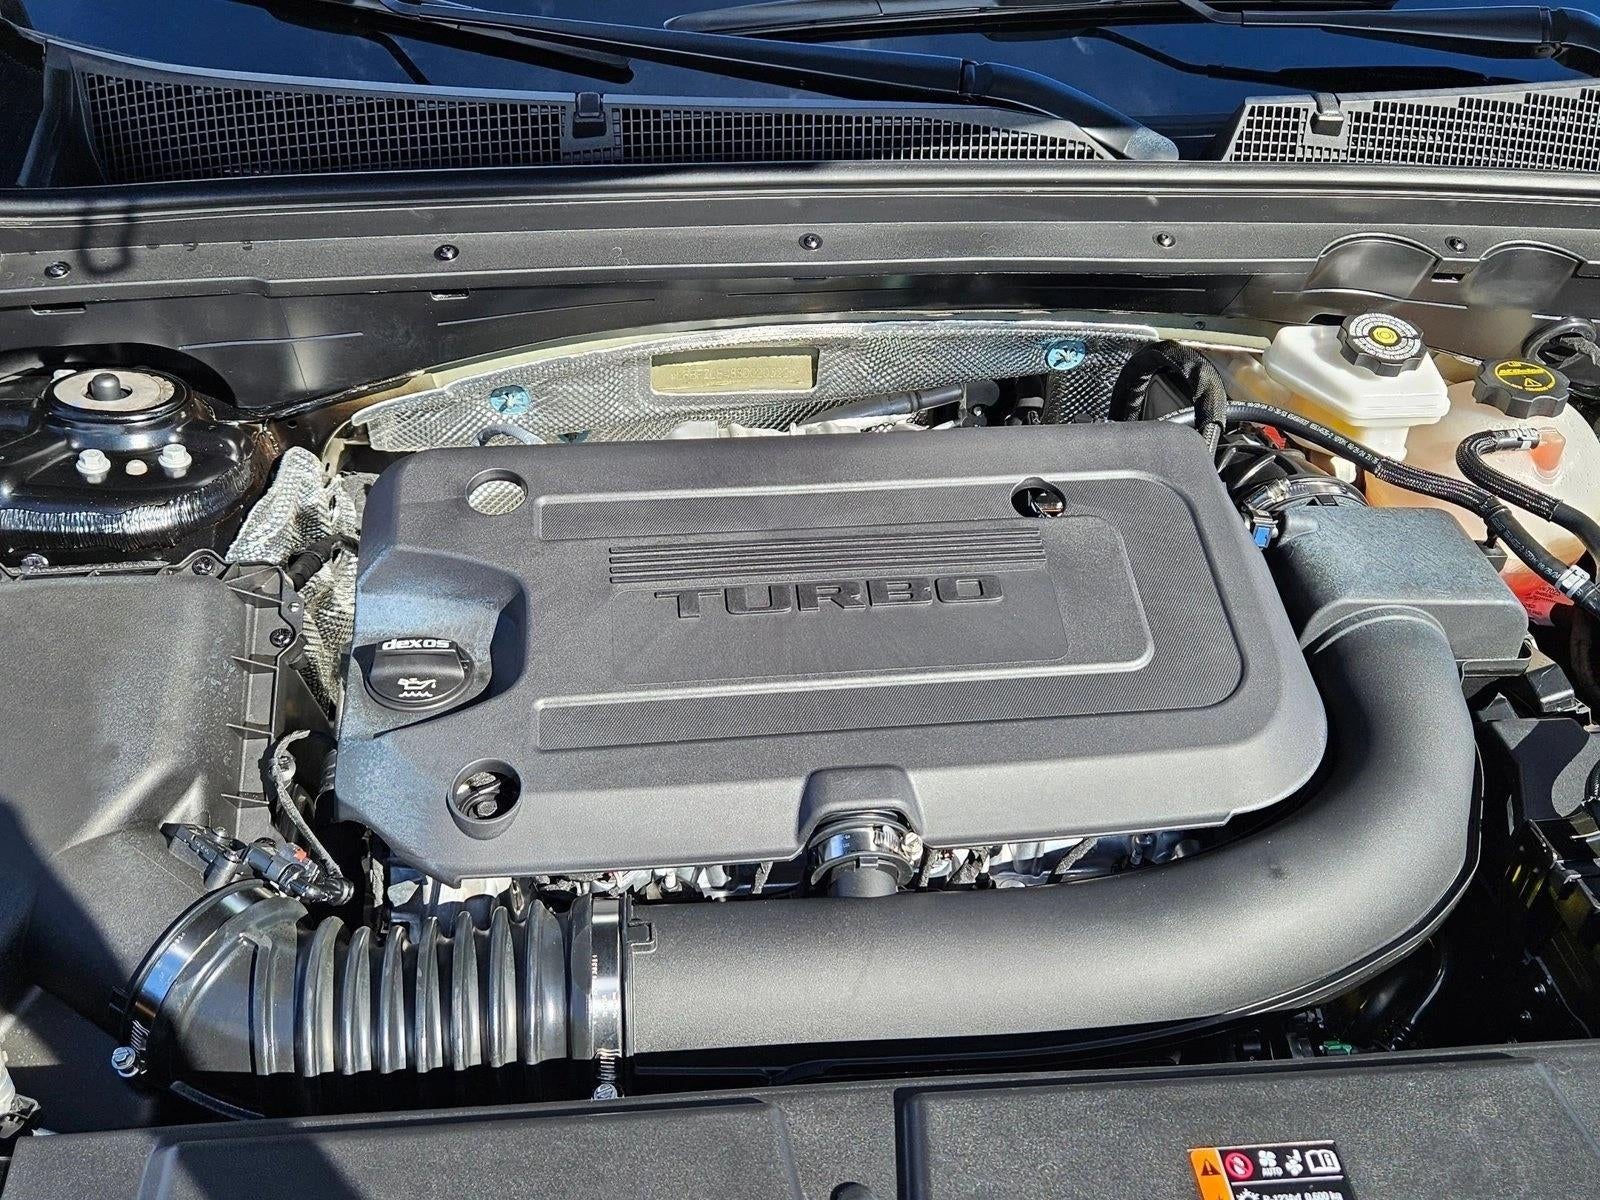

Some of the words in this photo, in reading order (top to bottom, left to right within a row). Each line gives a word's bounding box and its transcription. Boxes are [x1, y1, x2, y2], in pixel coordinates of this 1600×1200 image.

[654, 574, 1003, 619] TURBO
[382, 639, 452, 650] dexos
[1262, 1167, 1283, 1177] AUTO
